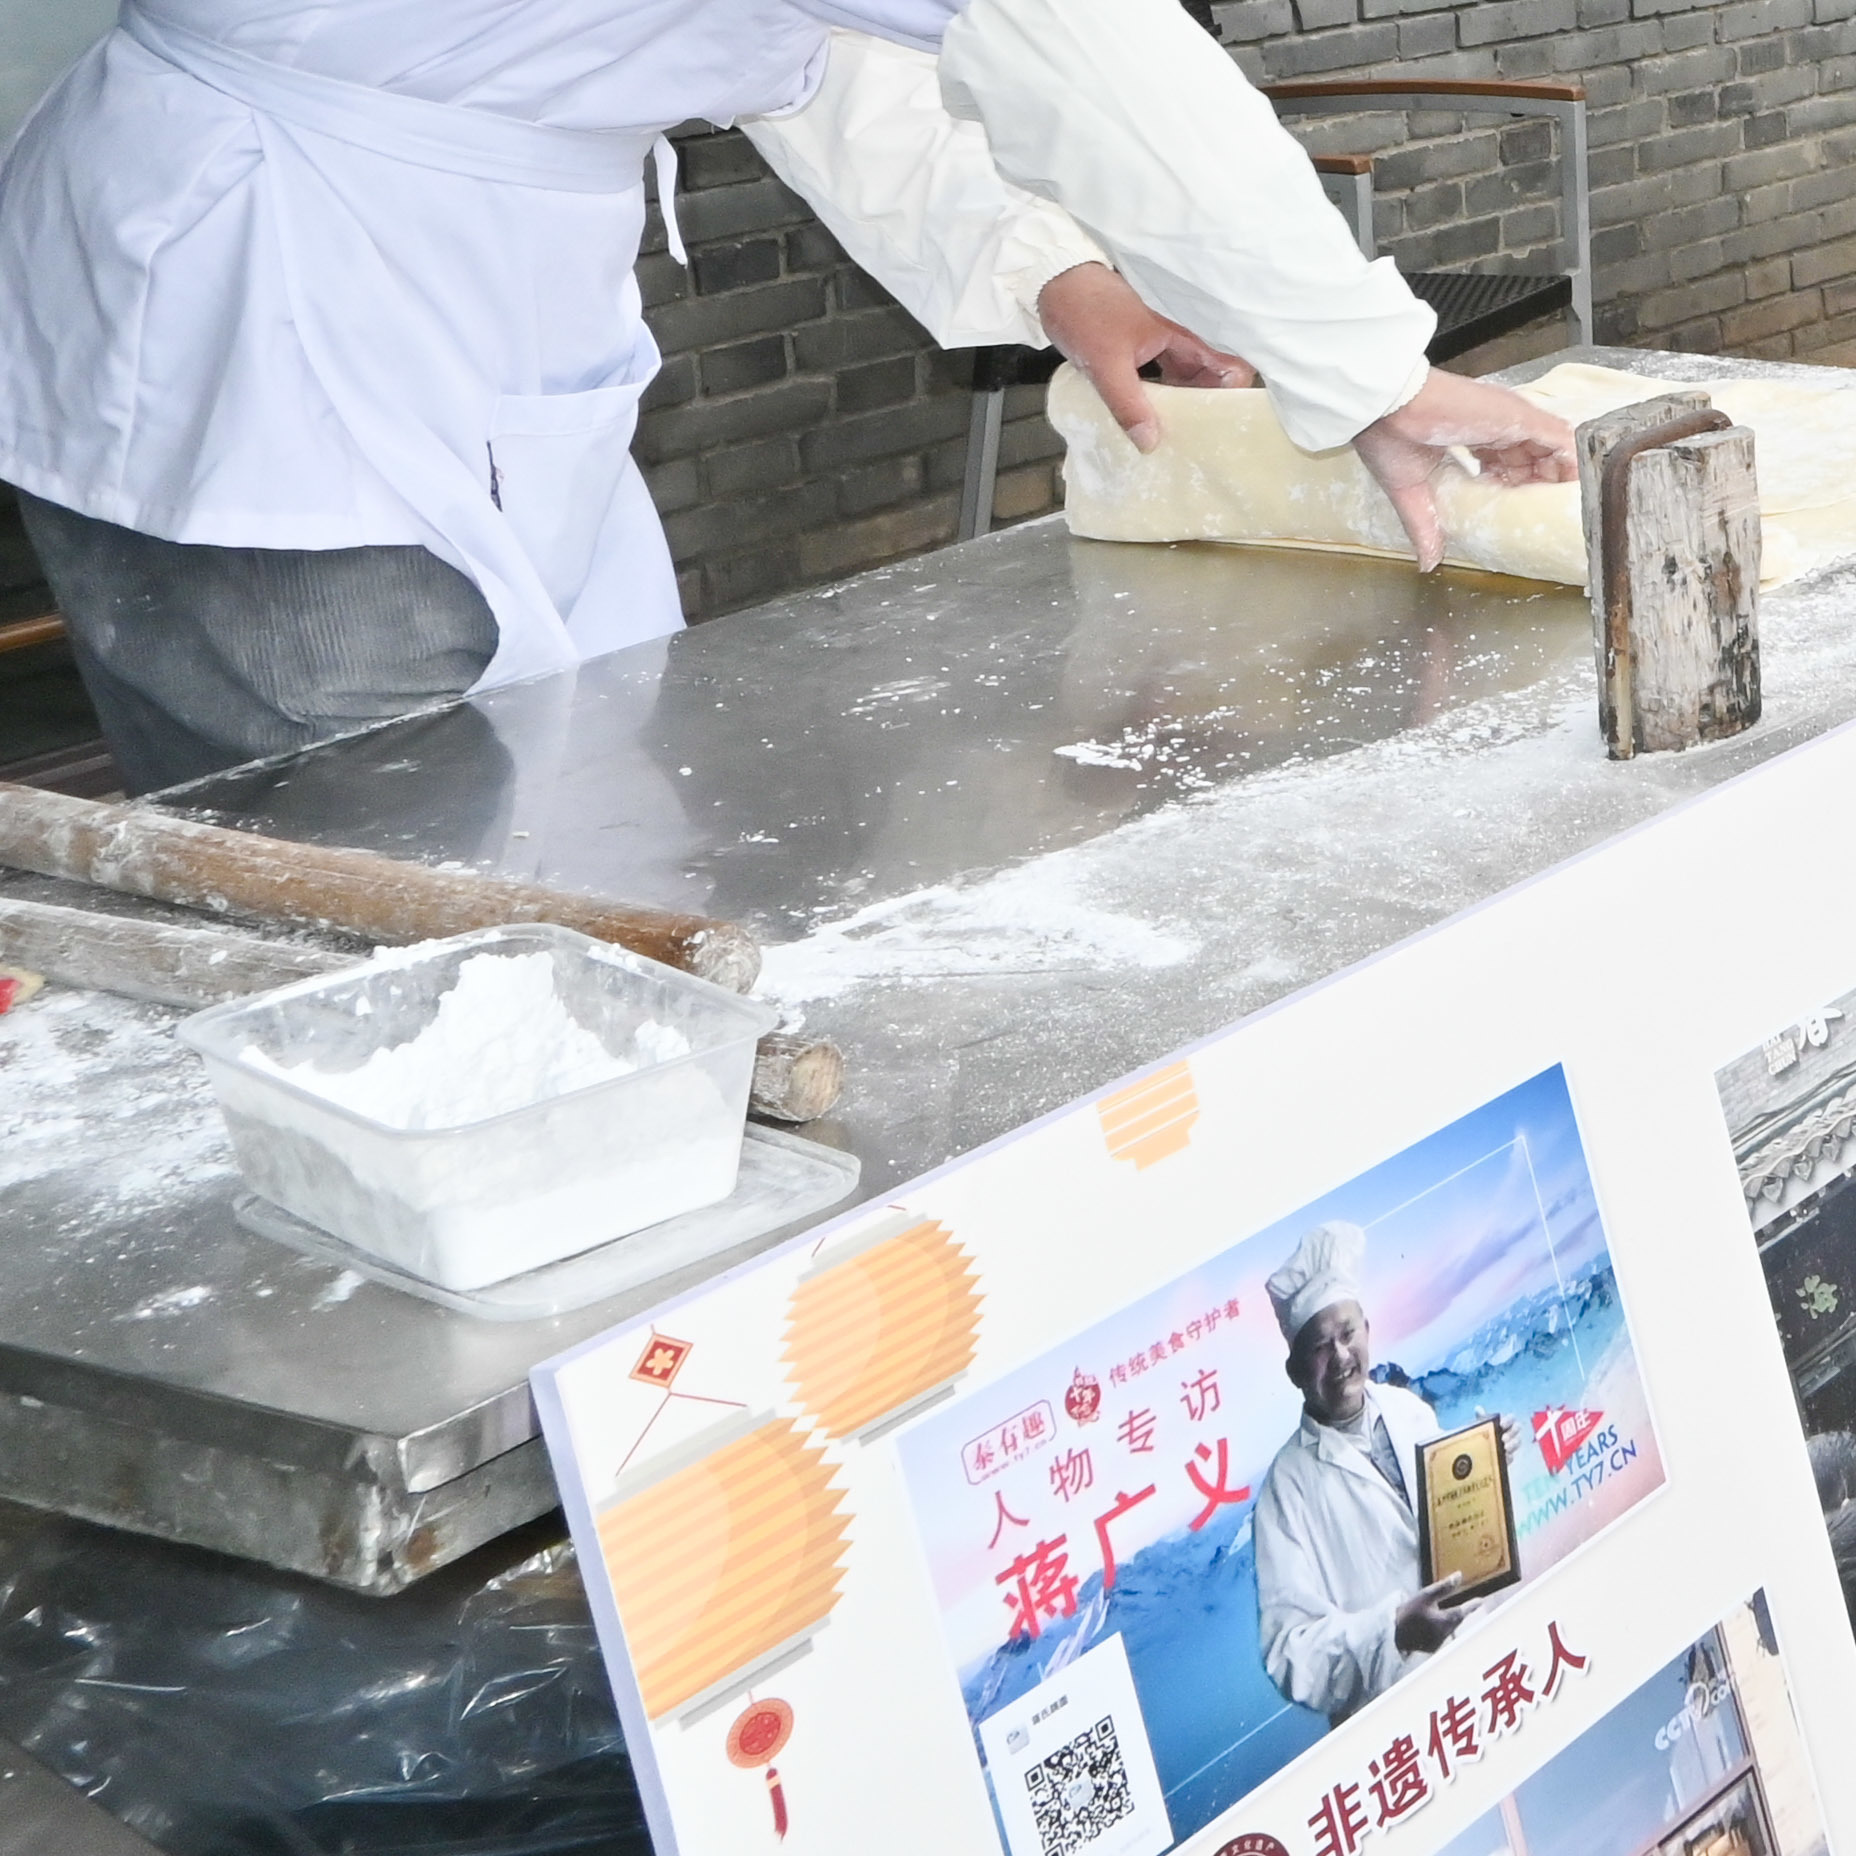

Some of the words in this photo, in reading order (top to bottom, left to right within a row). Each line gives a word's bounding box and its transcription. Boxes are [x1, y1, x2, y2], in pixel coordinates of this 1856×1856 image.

[1109, 1298, 1242, 1388] 传统美食守护者
[988, 1369, 1222, 1549] 人物专访
[995, 1438, 1250, 1639] 蒋广义
[1564, 1423, 1619, 1476] YEARS
[1308, 1621, 1588, 1856] 非遗传承人
